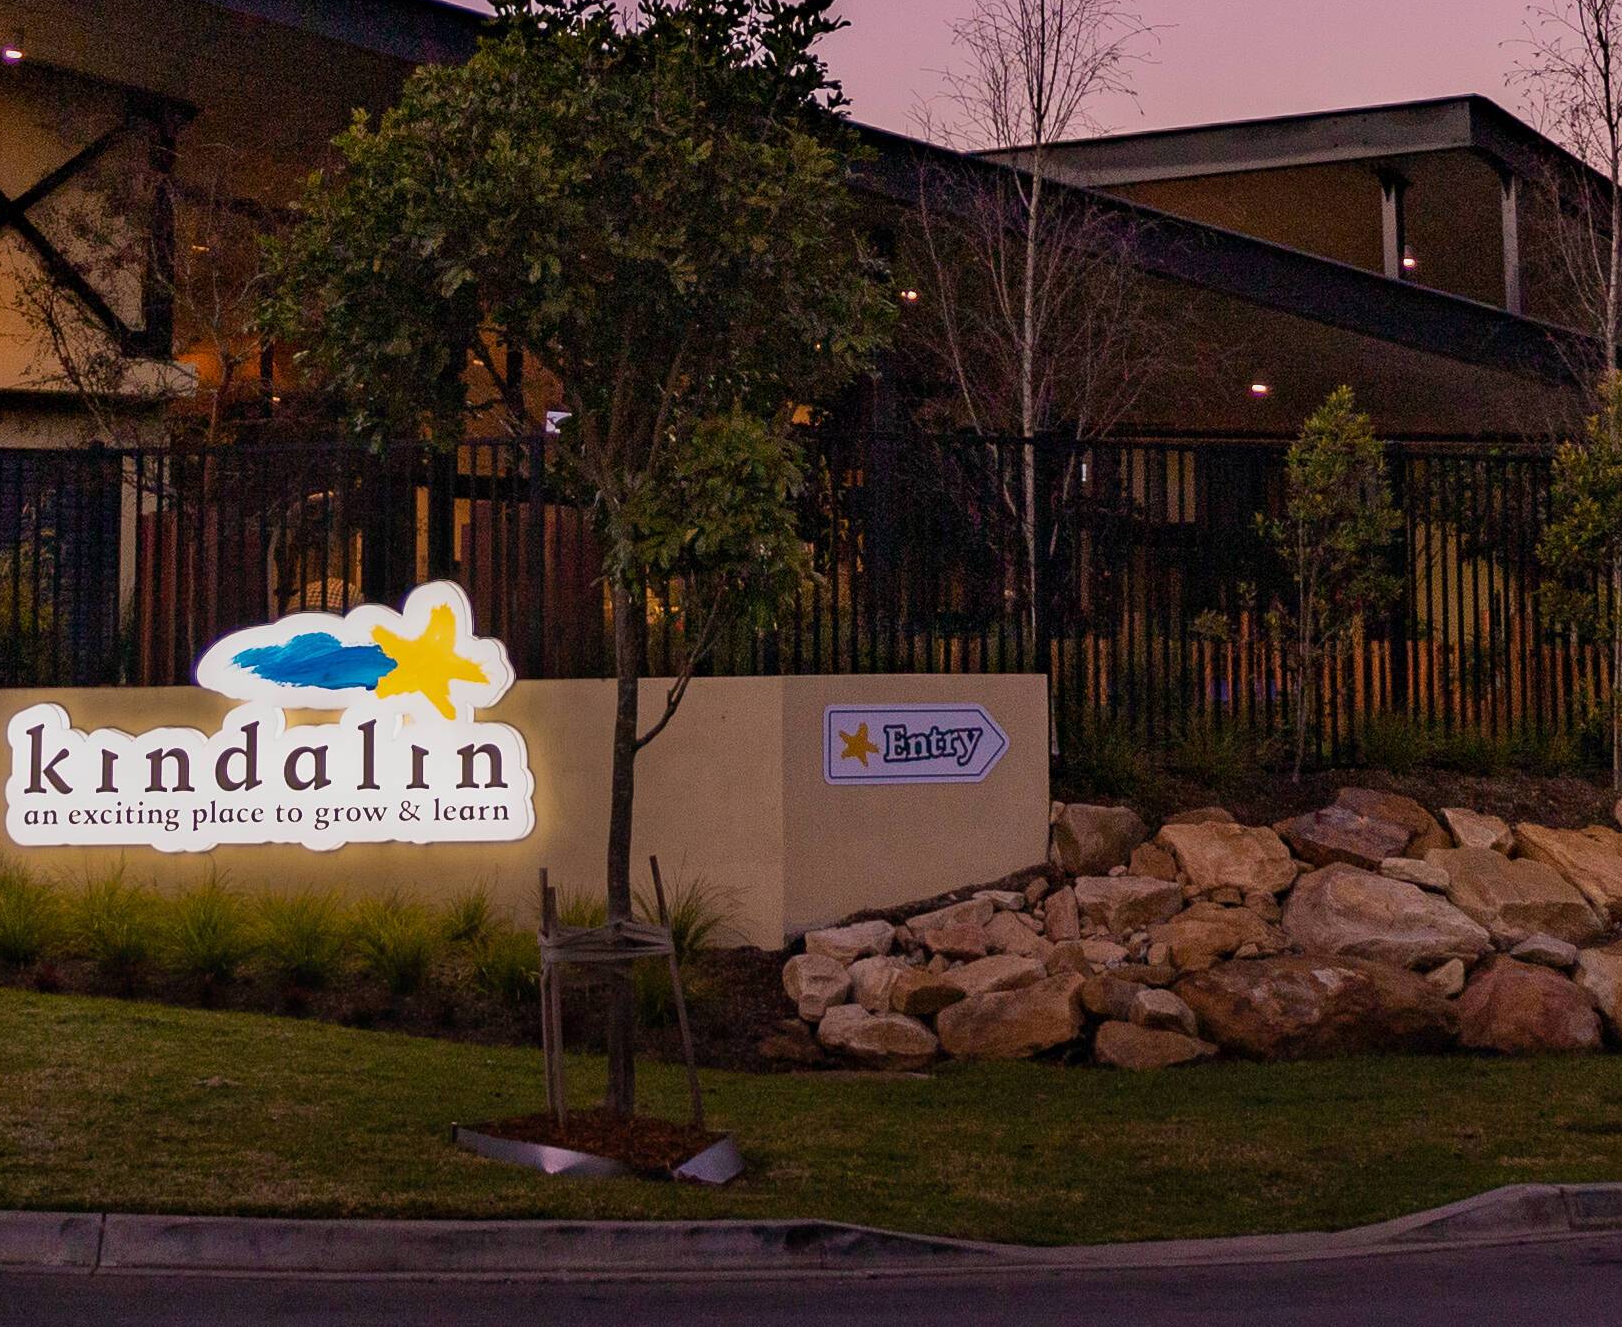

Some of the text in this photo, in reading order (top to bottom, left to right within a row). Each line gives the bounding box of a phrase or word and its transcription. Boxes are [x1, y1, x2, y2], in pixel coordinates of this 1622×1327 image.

[23, 718, 509, 795] kindalin
[883, 724, 983, 766] Entry
[23, 797, 510, 832] an exciting place to grow & learn
